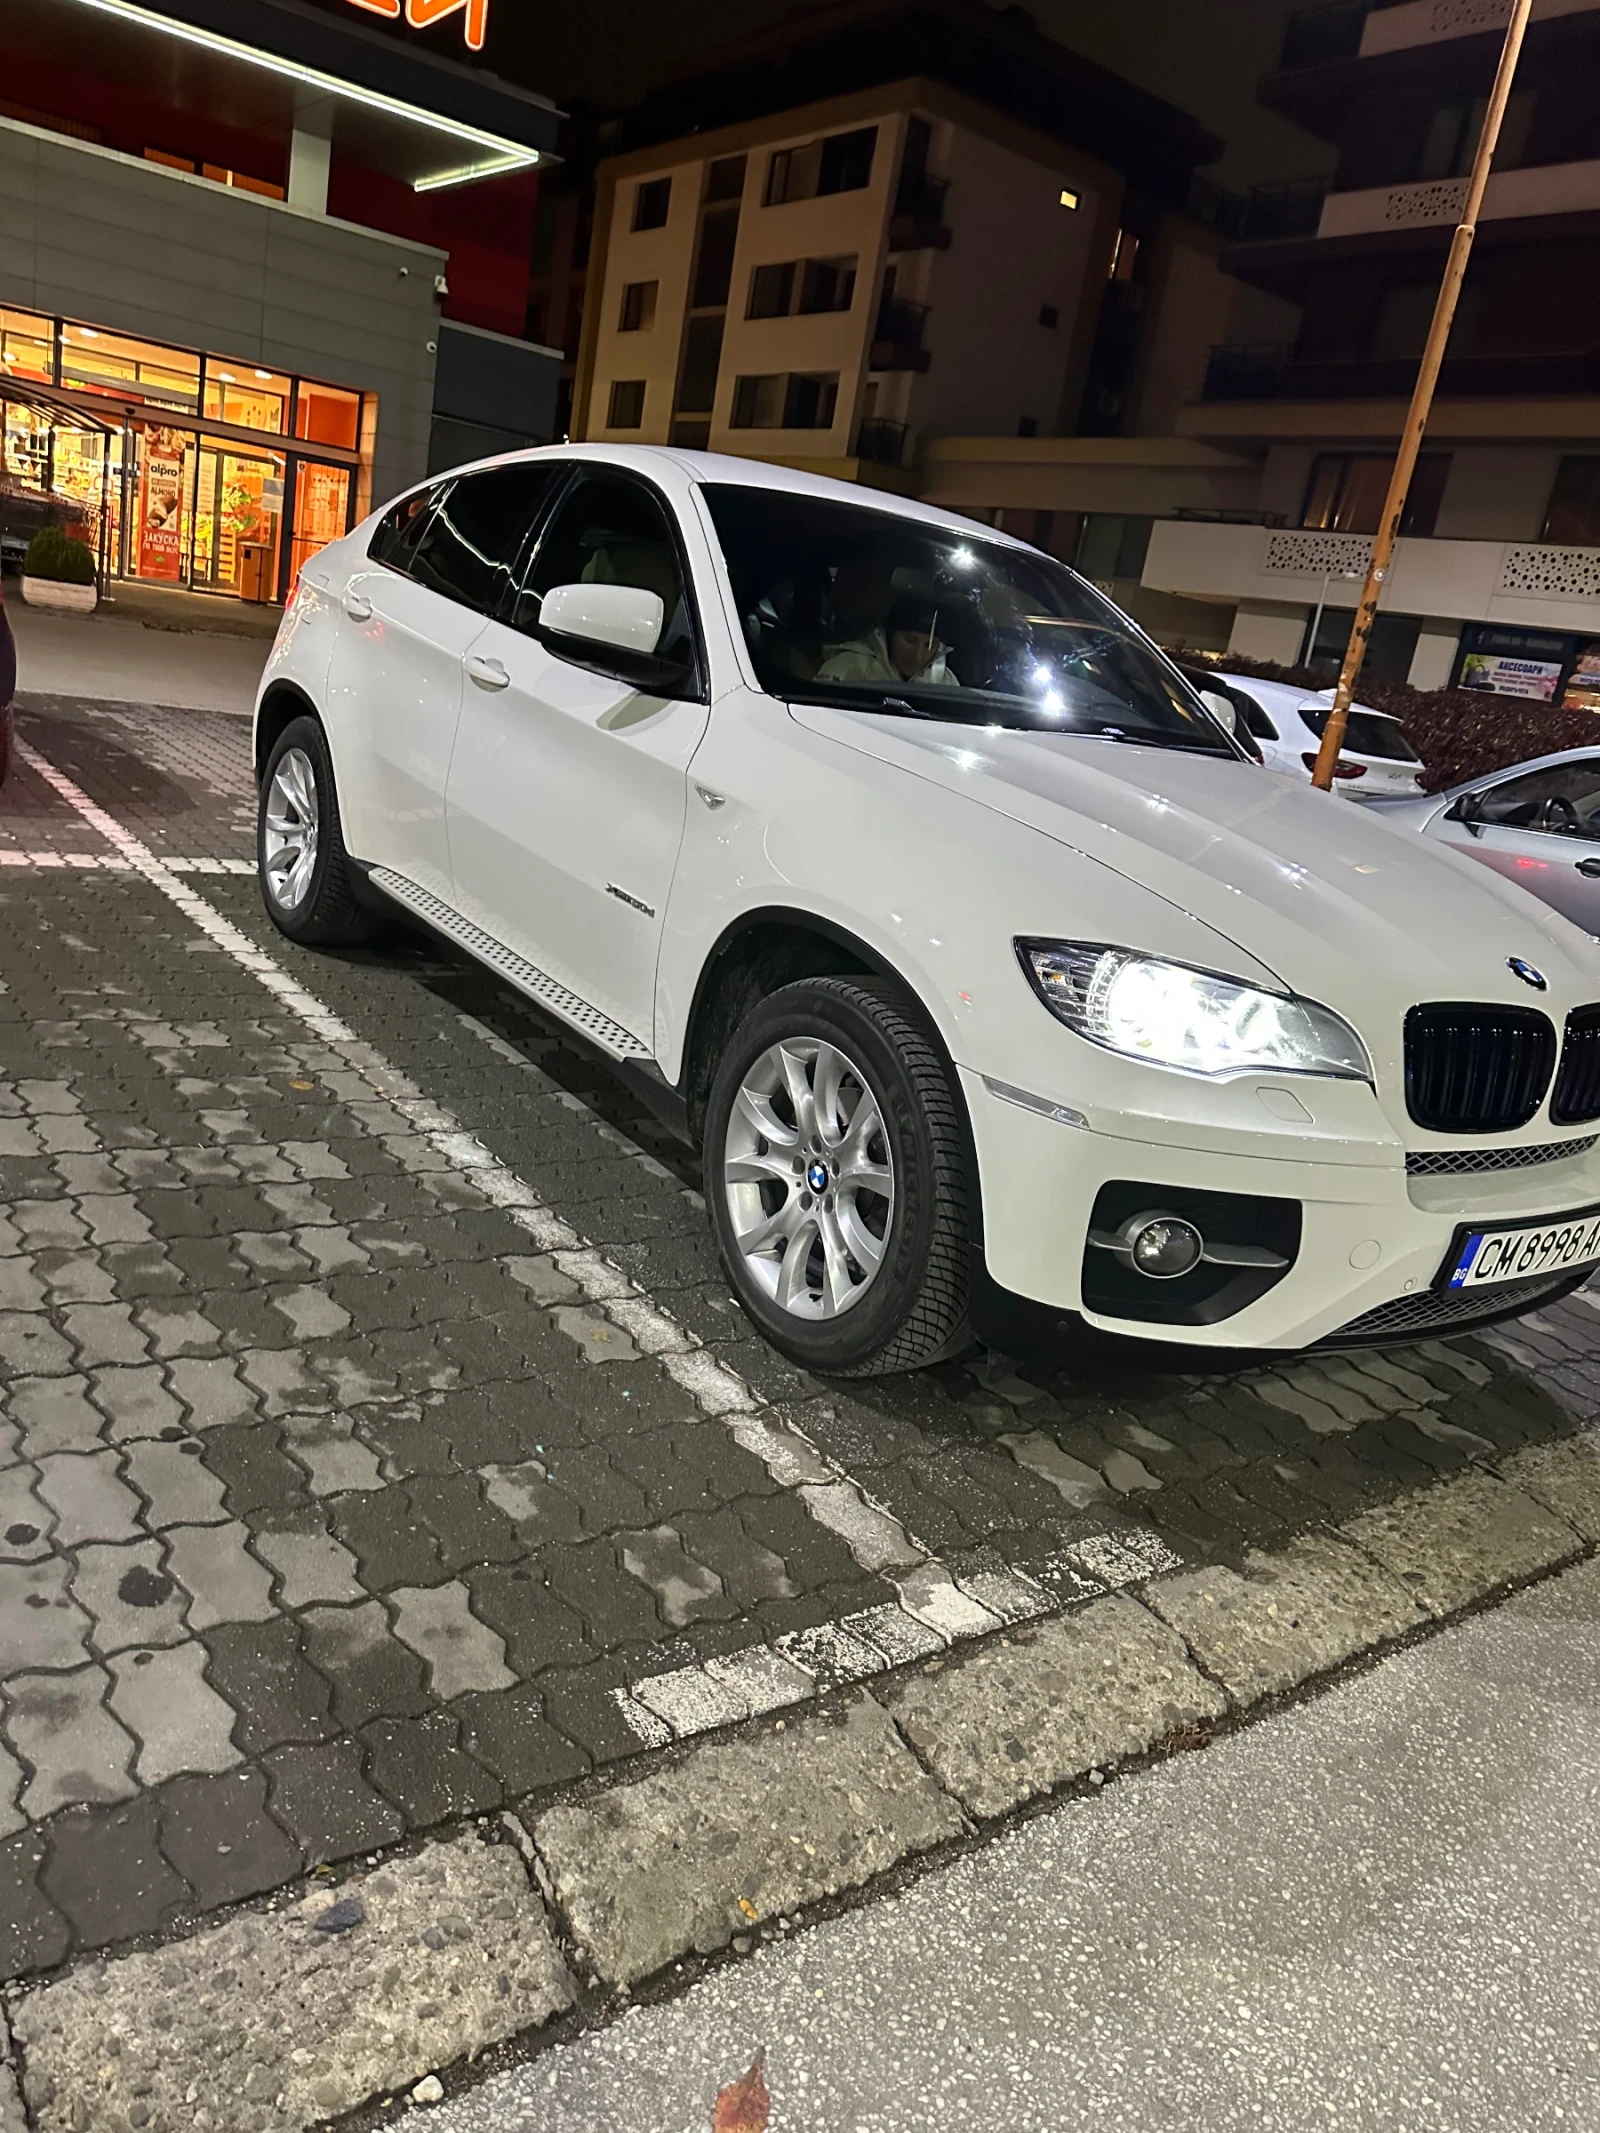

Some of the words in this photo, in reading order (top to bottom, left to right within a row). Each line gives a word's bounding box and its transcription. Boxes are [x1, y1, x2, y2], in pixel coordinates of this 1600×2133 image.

[151, 463, 178, 477] alpro
[143, 531, 179, 546] ЗАКУСКА
[1498, 660, 1544, 675] АКСЕСОАРИ
[1452, 1268, 1468, 1281] BG
